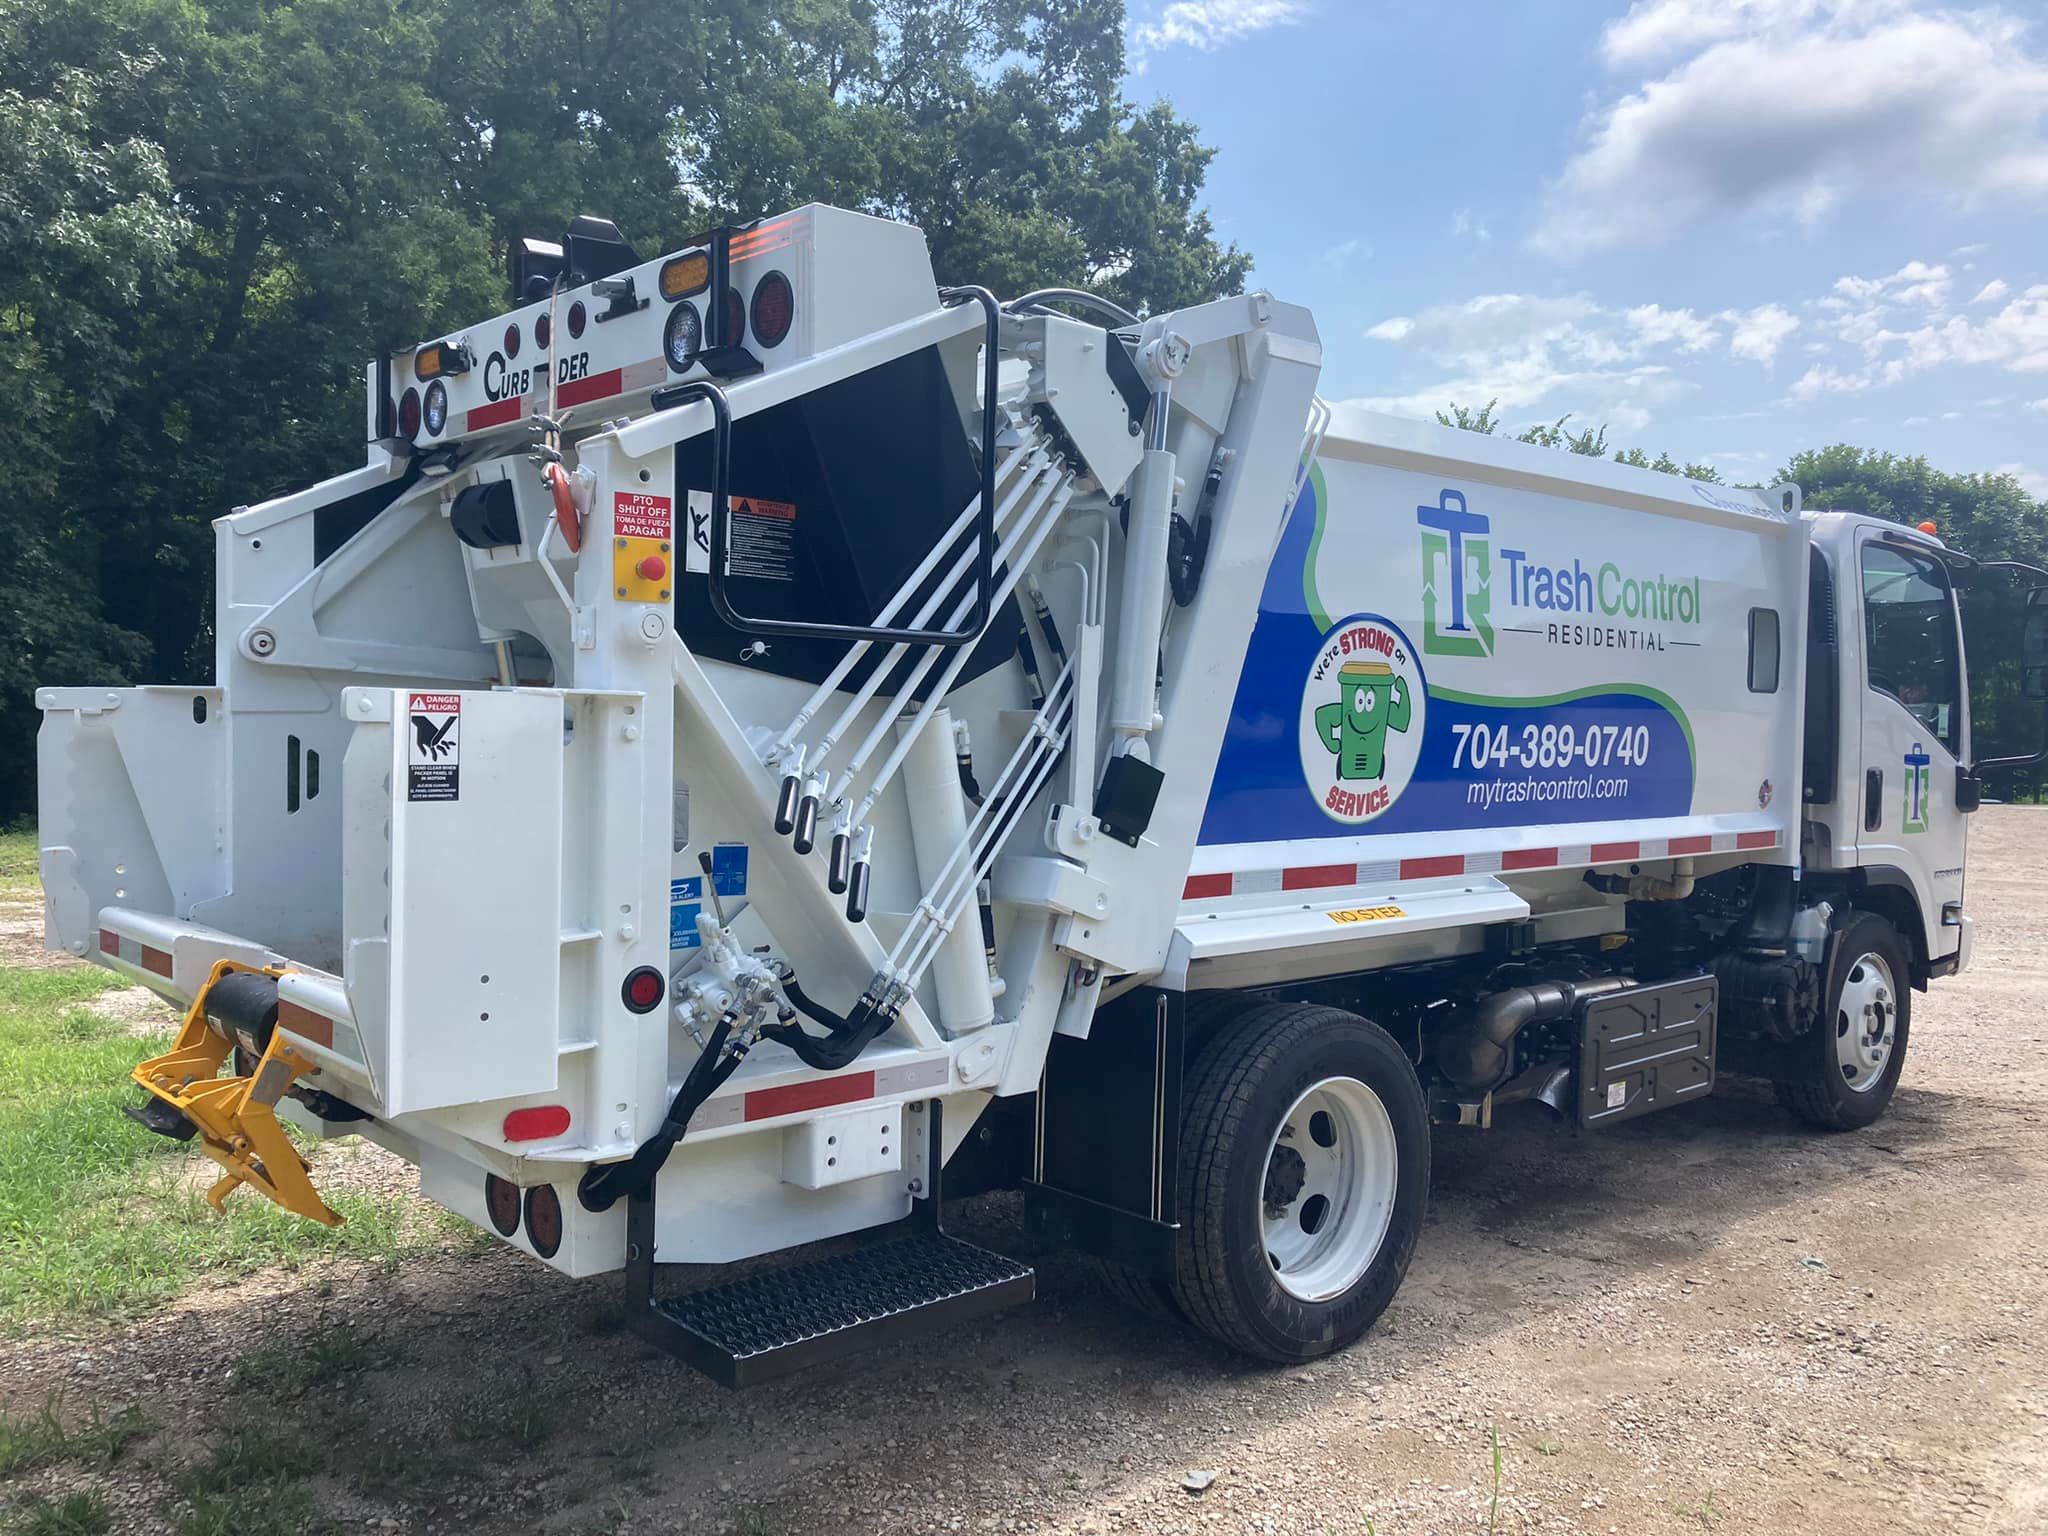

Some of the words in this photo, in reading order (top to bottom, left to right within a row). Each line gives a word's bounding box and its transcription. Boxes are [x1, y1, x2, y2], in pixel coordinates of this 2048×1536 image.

[483, 351, 530, 402] CURB
[632, 495, 654, 506] PTO
[618, 503, 646, 515] SHUT
[647, 507, 668, 517] OFF
[615, 515, 636, 525] TOMA
[636, 518, 647, 526] DE
[621, 524, 664, 537] APAGAR
[1548, 624, 1665, 651] RESIDENTIAL
[1314, 645, 1340, 681] We're
[1339, 627, 1395, 658] STRONG
[1394, 648, 1406, 666] on
[426, 695, 459, 704] DANGER
[427, 703, 458, 711] PELIGRO
[1451, 723, 1650, 769] 704-389-0740
[1325, 784, 1390, 816] SERVICE
[1466, 774, 1629, 810] mytrashcontrol.com
[1327, 910, 1358, 922] NO
[1356, 906, 1402, 921] STEP
